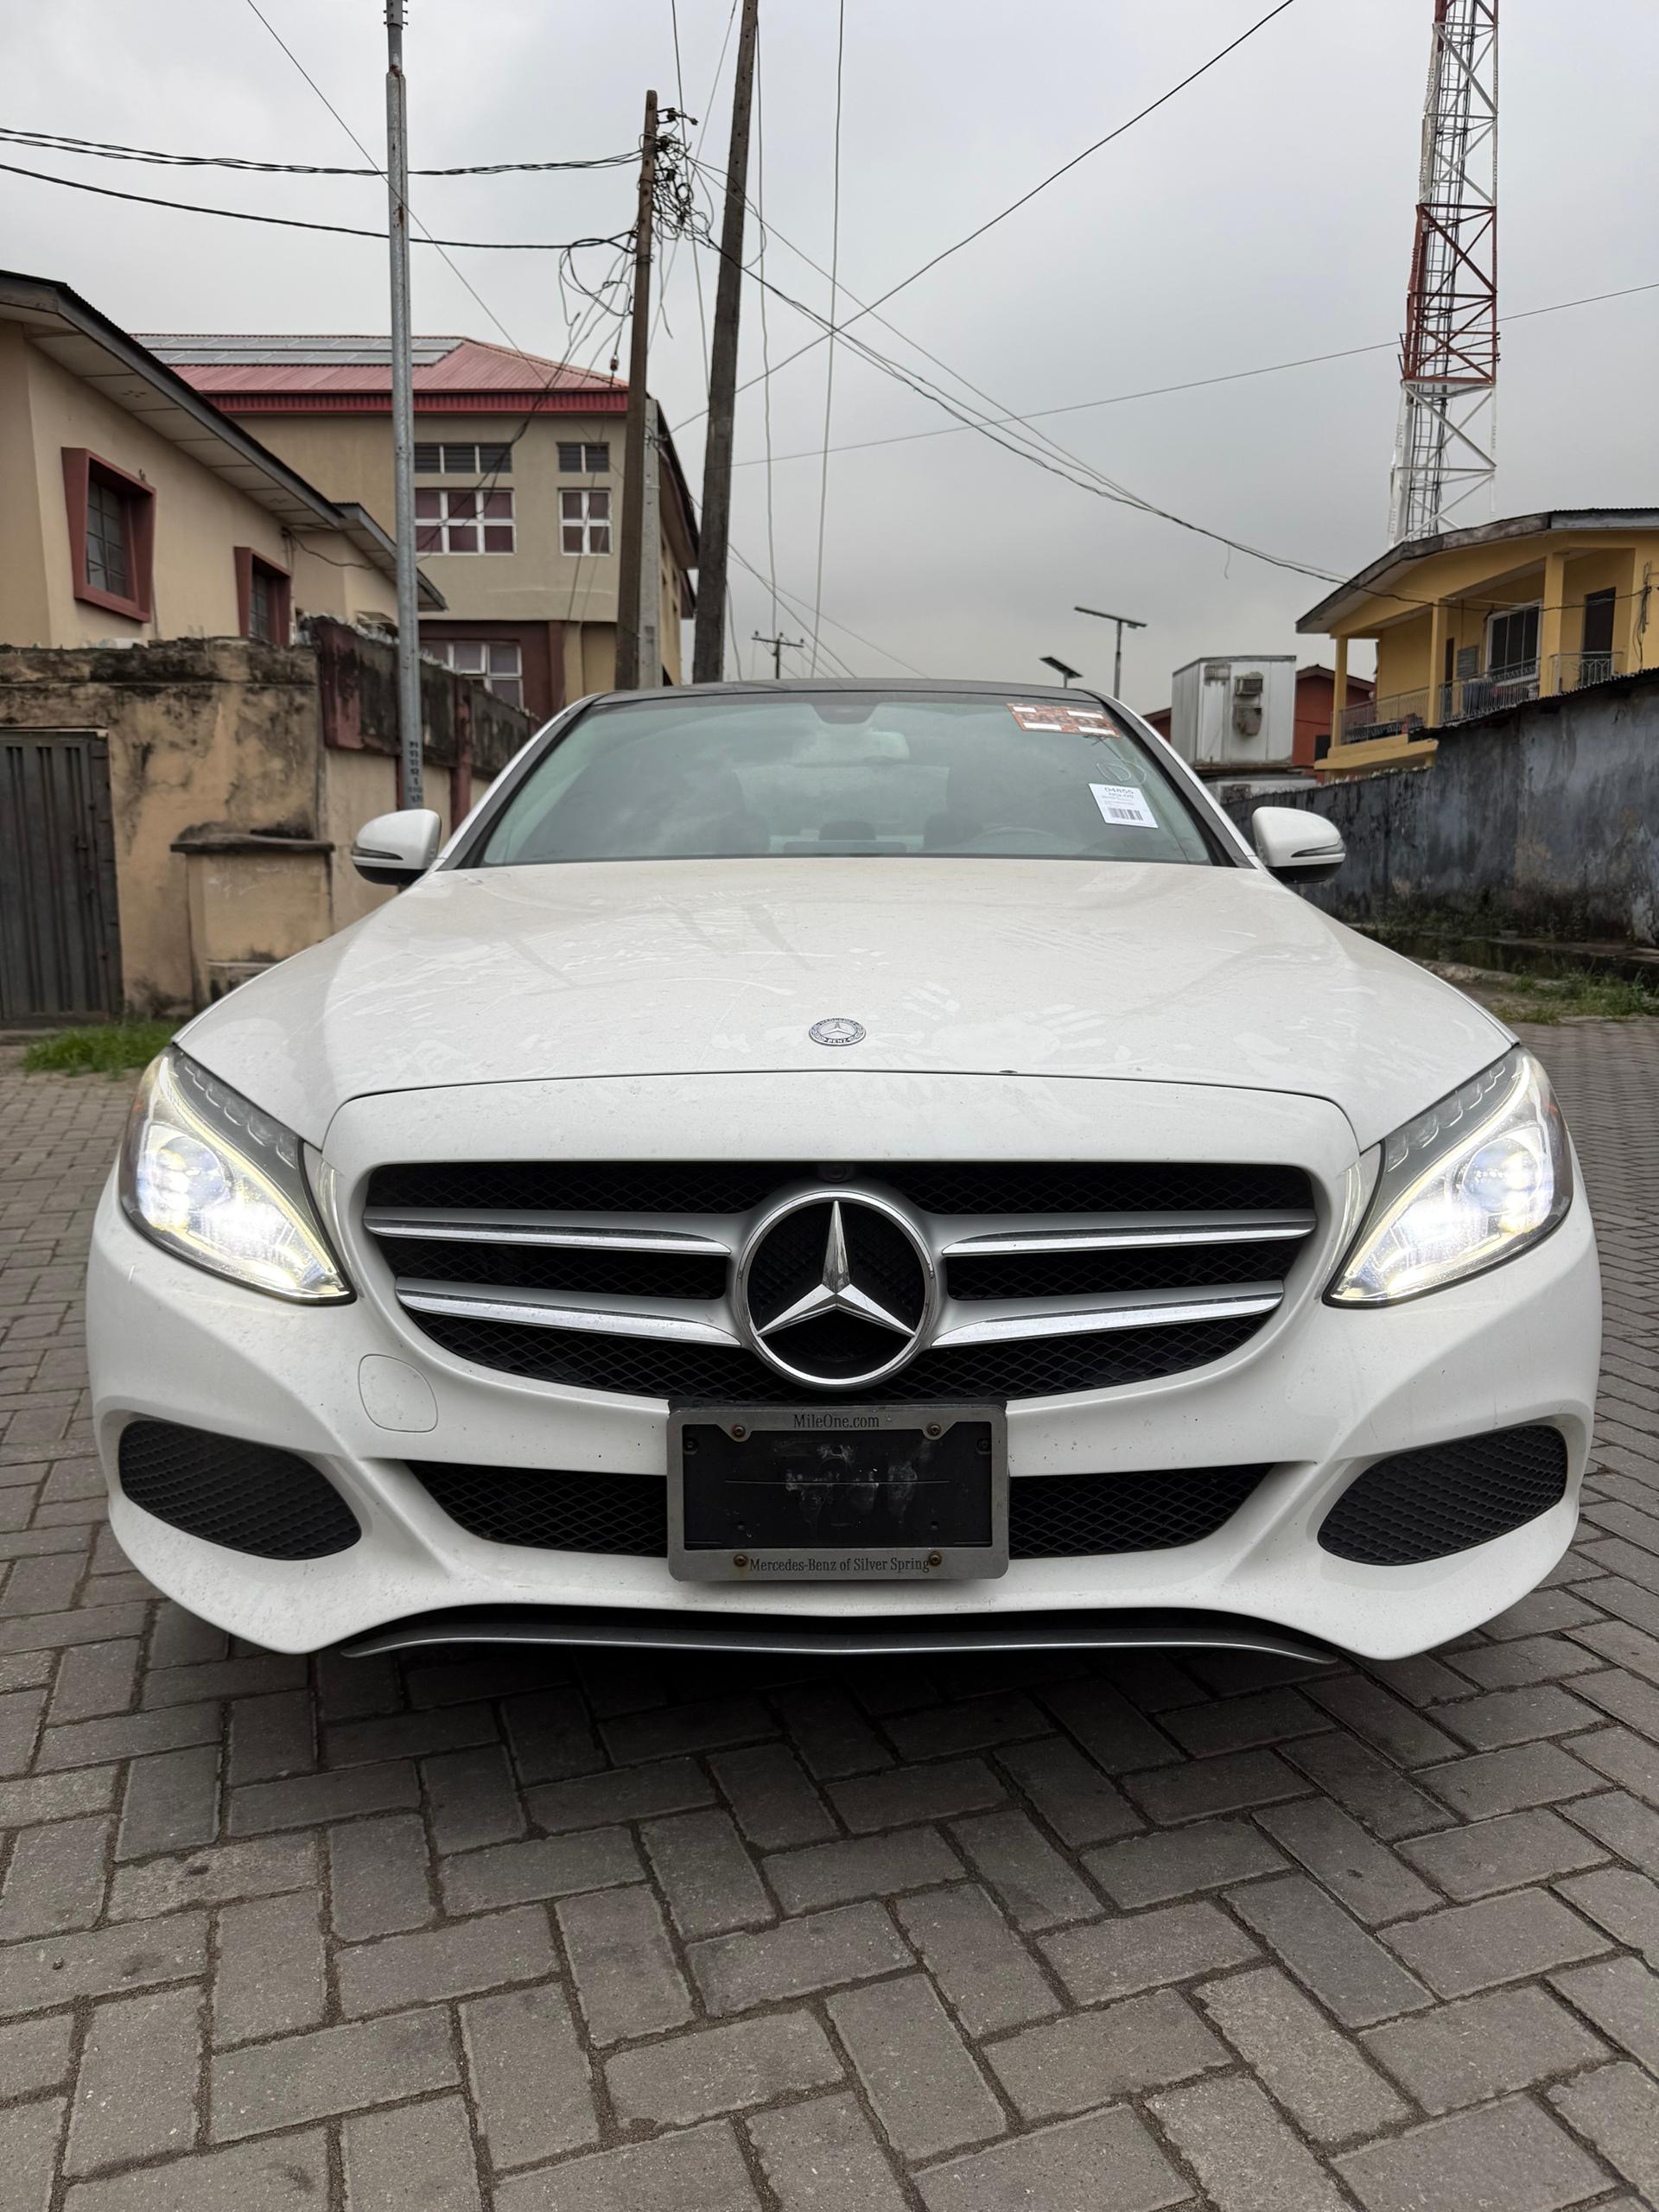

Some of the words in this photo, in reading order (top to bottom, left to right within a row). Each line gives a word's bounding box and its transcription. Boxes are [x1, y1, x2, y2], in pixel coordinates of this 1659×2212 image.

[793, 1414, 880, 1428] MileOne.com
[750, 1558, 836, 1571] Mercedes-Benz
[840, 1558, 853, 1571] of
[854, 1557, 888, 1570] Silver
[890, 1557, 931, 1573] Spring
